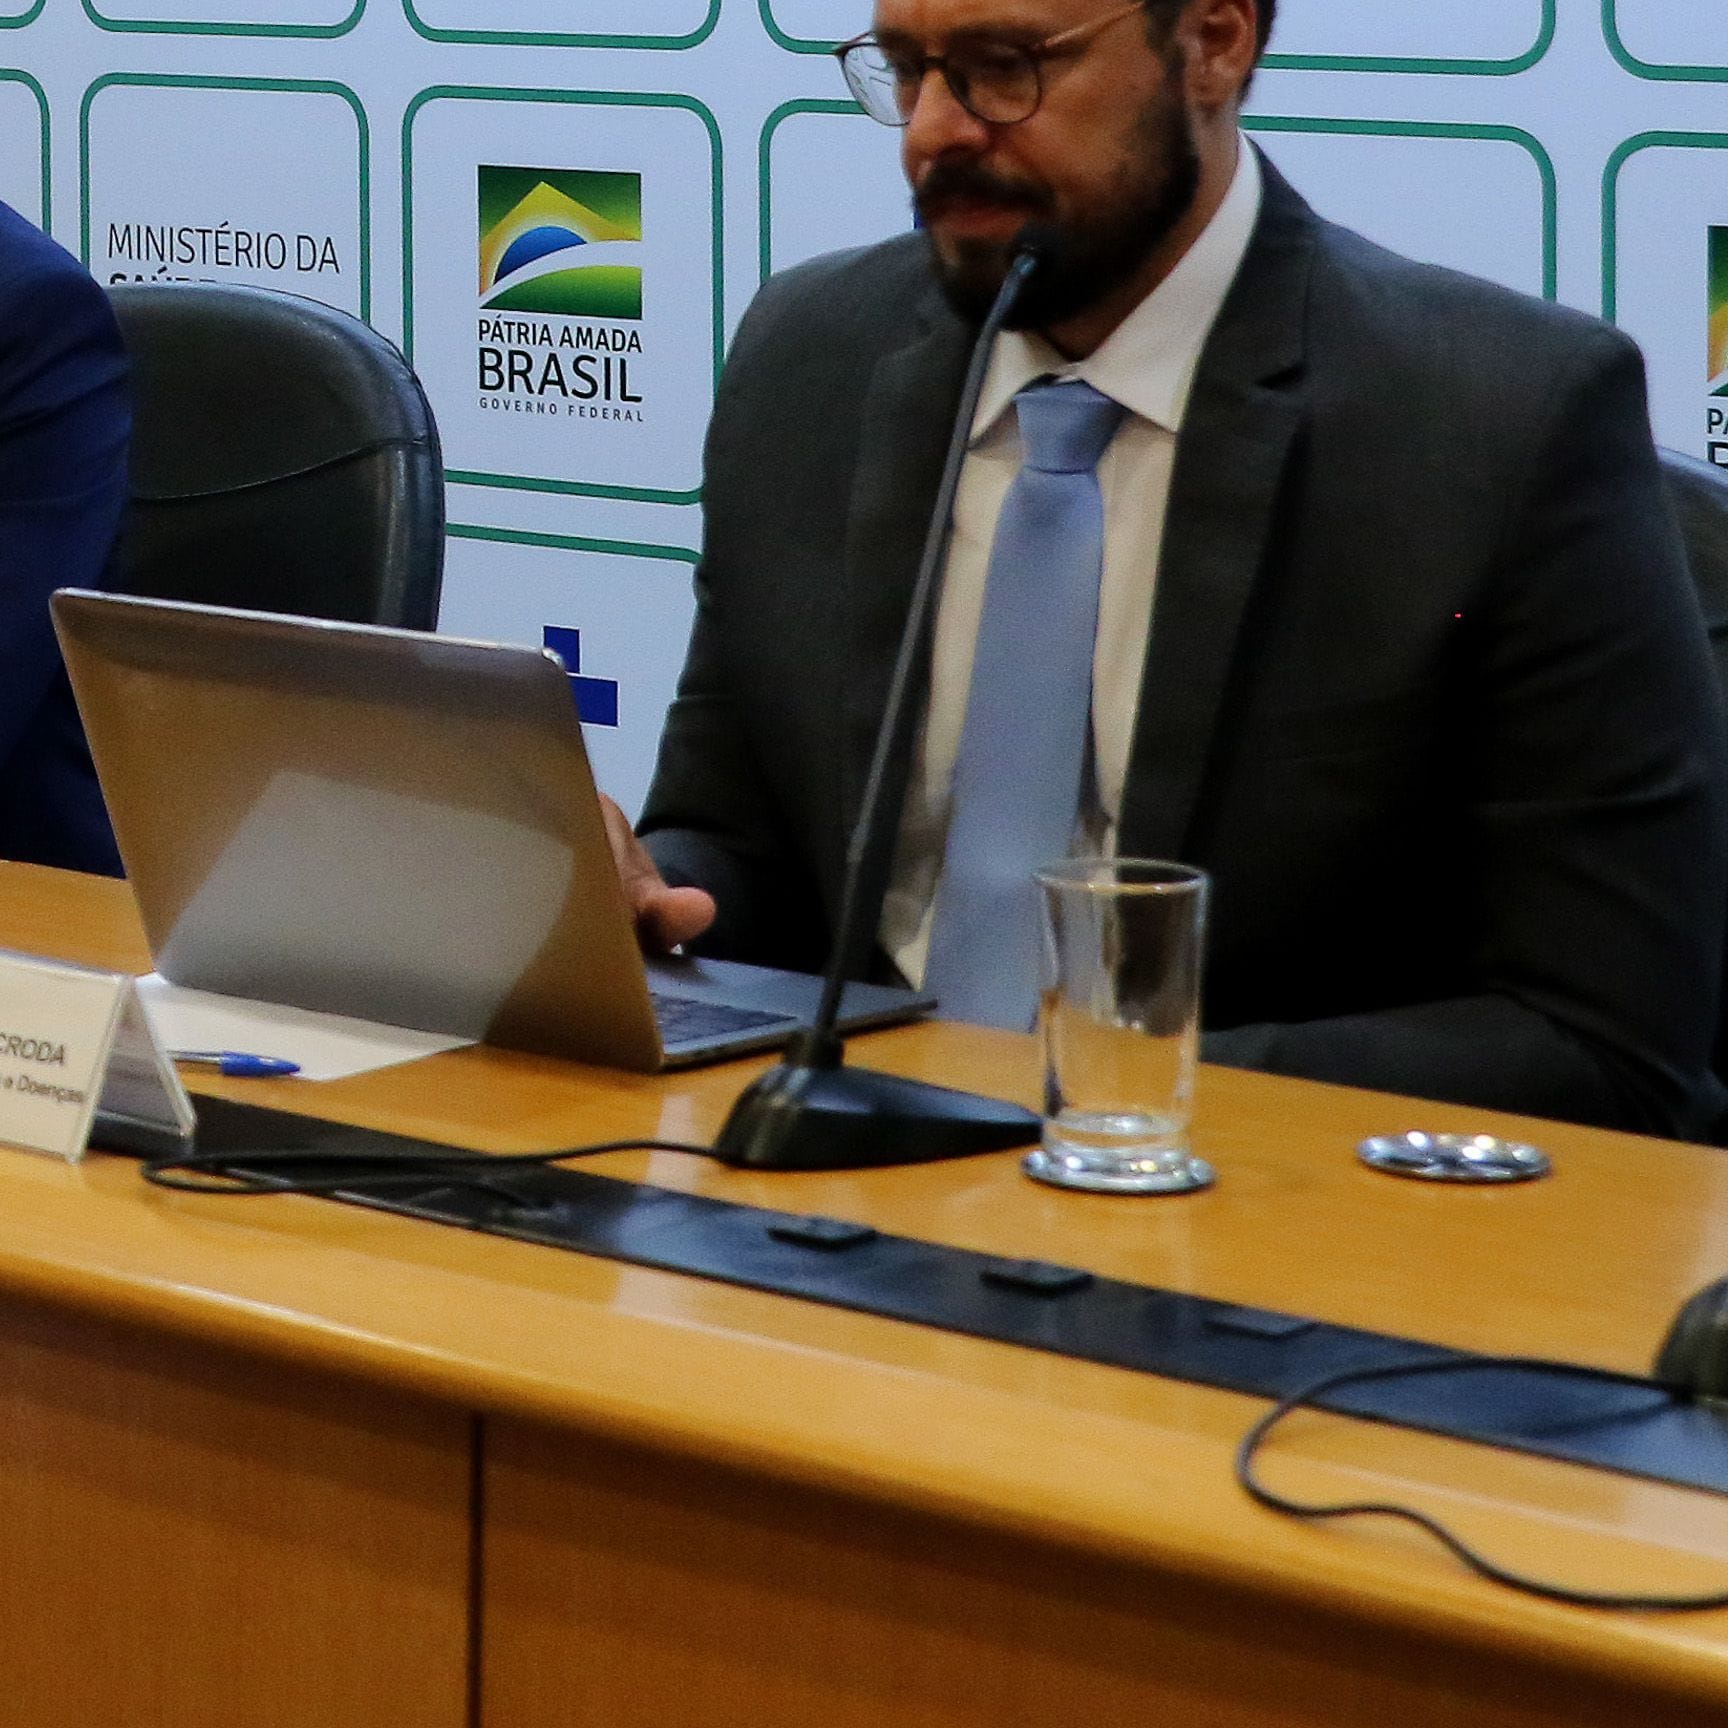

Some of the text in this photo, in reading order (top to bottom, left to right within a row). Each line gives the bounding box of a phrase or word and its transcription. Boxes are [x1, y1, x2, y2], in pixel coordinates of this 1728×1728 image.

[108, 220, 340, 275] MINISTÉRIO DA
[478, 313, 643, 354] PÁTRIA AMADA
[478, 346, 643, 404] BRASIL
[479, 396, 644, 423] GOVERNO FEDERAL
